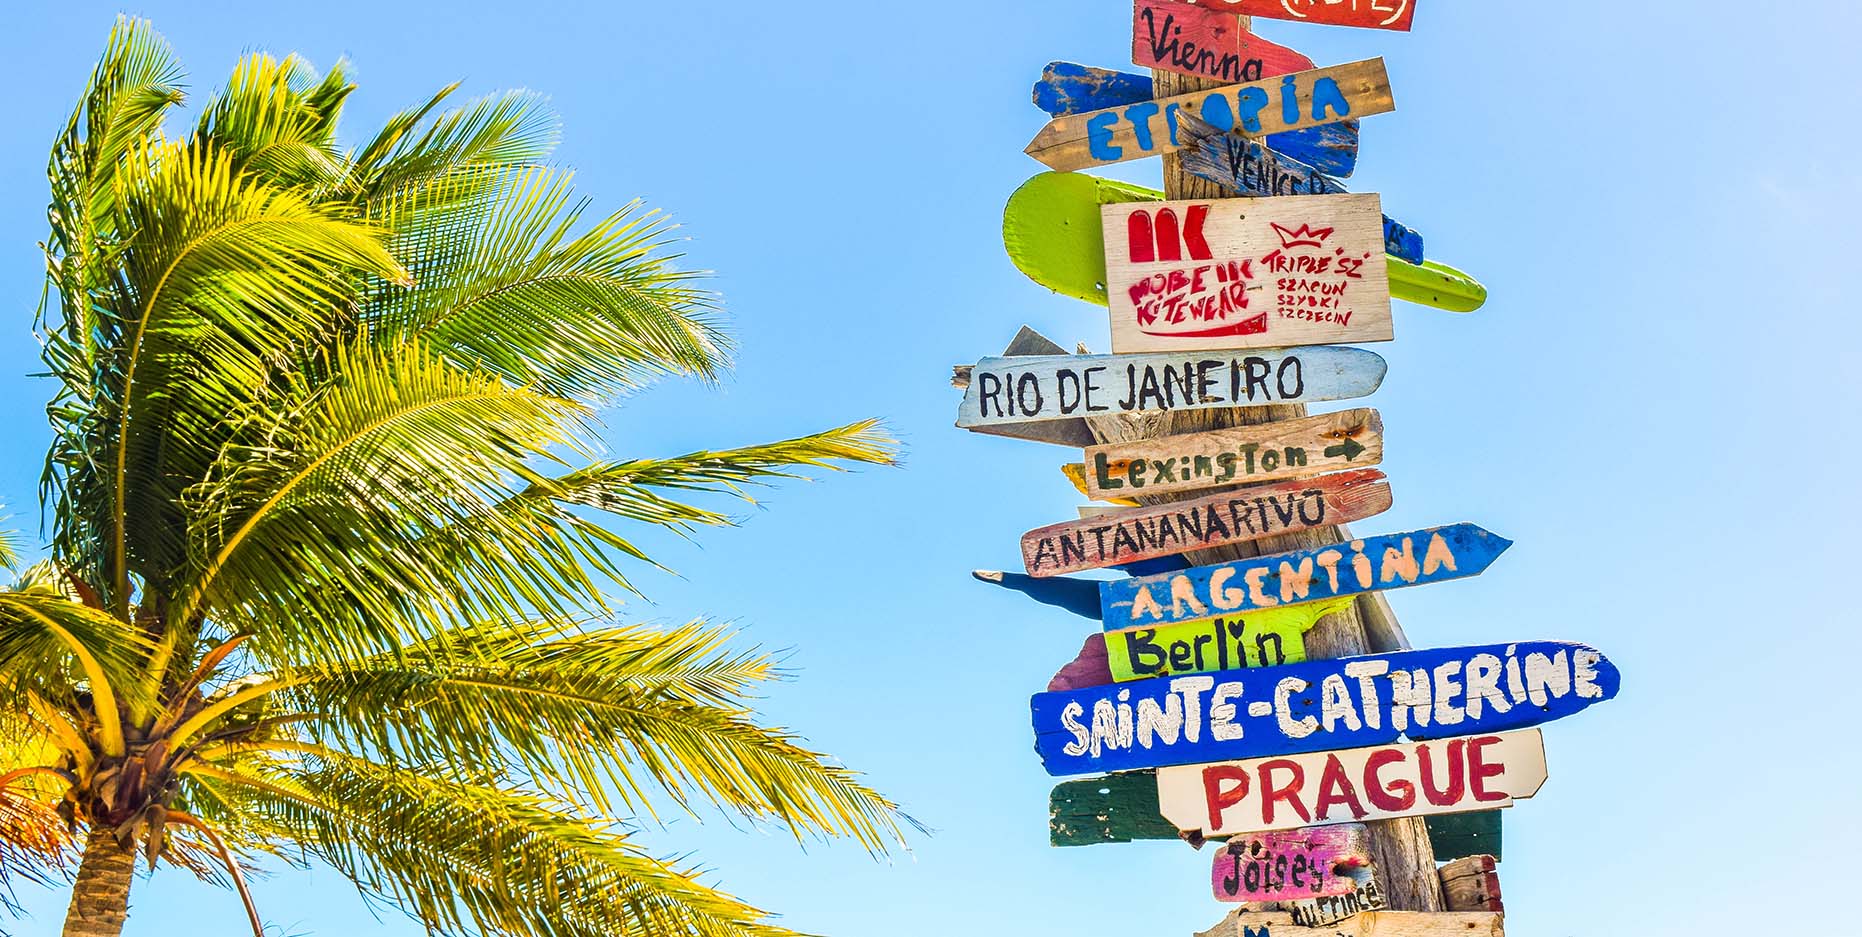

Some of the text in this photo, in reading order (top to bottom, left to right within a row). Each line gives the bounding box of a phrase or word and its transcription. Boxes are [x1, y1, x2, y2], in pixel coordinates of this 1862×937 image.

[1141, 7, 1263, 81] Vienna
[1260, 249, 1333, 274] TRIPLE
[1277, 278, 1348, 296] SZACUN
[1277, 294, 1339, 310] SZYBKI
[1277, 307, 1353, 327] SZCZECIN
[979, 355, 1305, 418] RIO DE JANEIRO
[1033, 488, 1325, 572] ANTANANARIVO
[1124, 618, 1287, 675] Berlin
[1202, 736, 1508, 831] PRAGUE
[1223, 840, 1324, 896] Joisey
